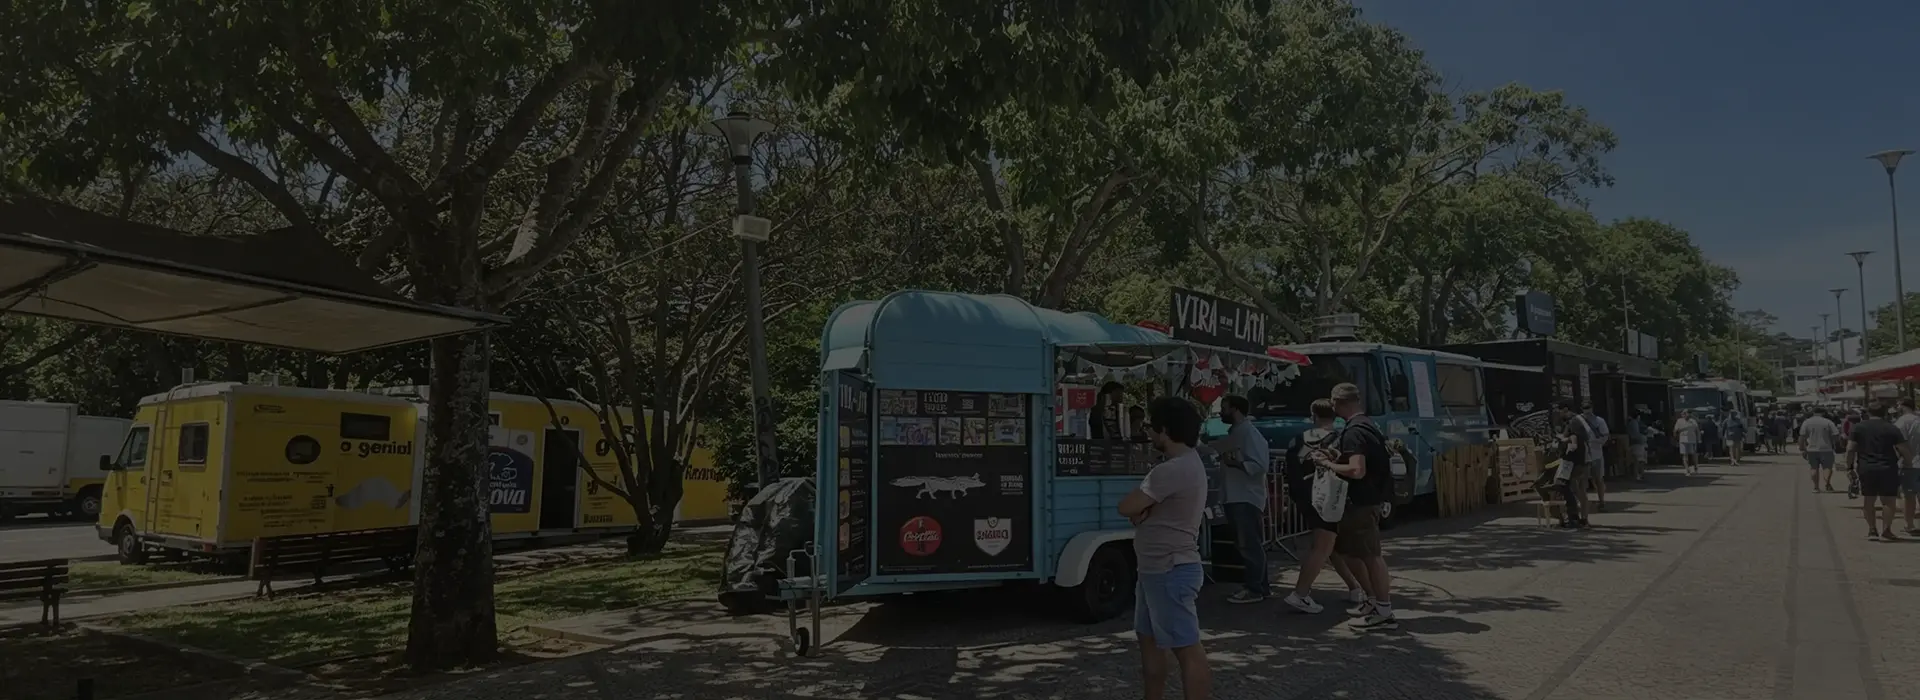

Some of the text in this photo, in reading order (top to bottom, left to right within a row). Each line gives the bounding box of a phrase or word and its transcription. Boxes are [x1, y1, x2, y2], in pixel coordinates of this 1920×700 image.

[1175, 293, 1264, 346] VIRA LATA
[358, 441, 412, 457] genial
